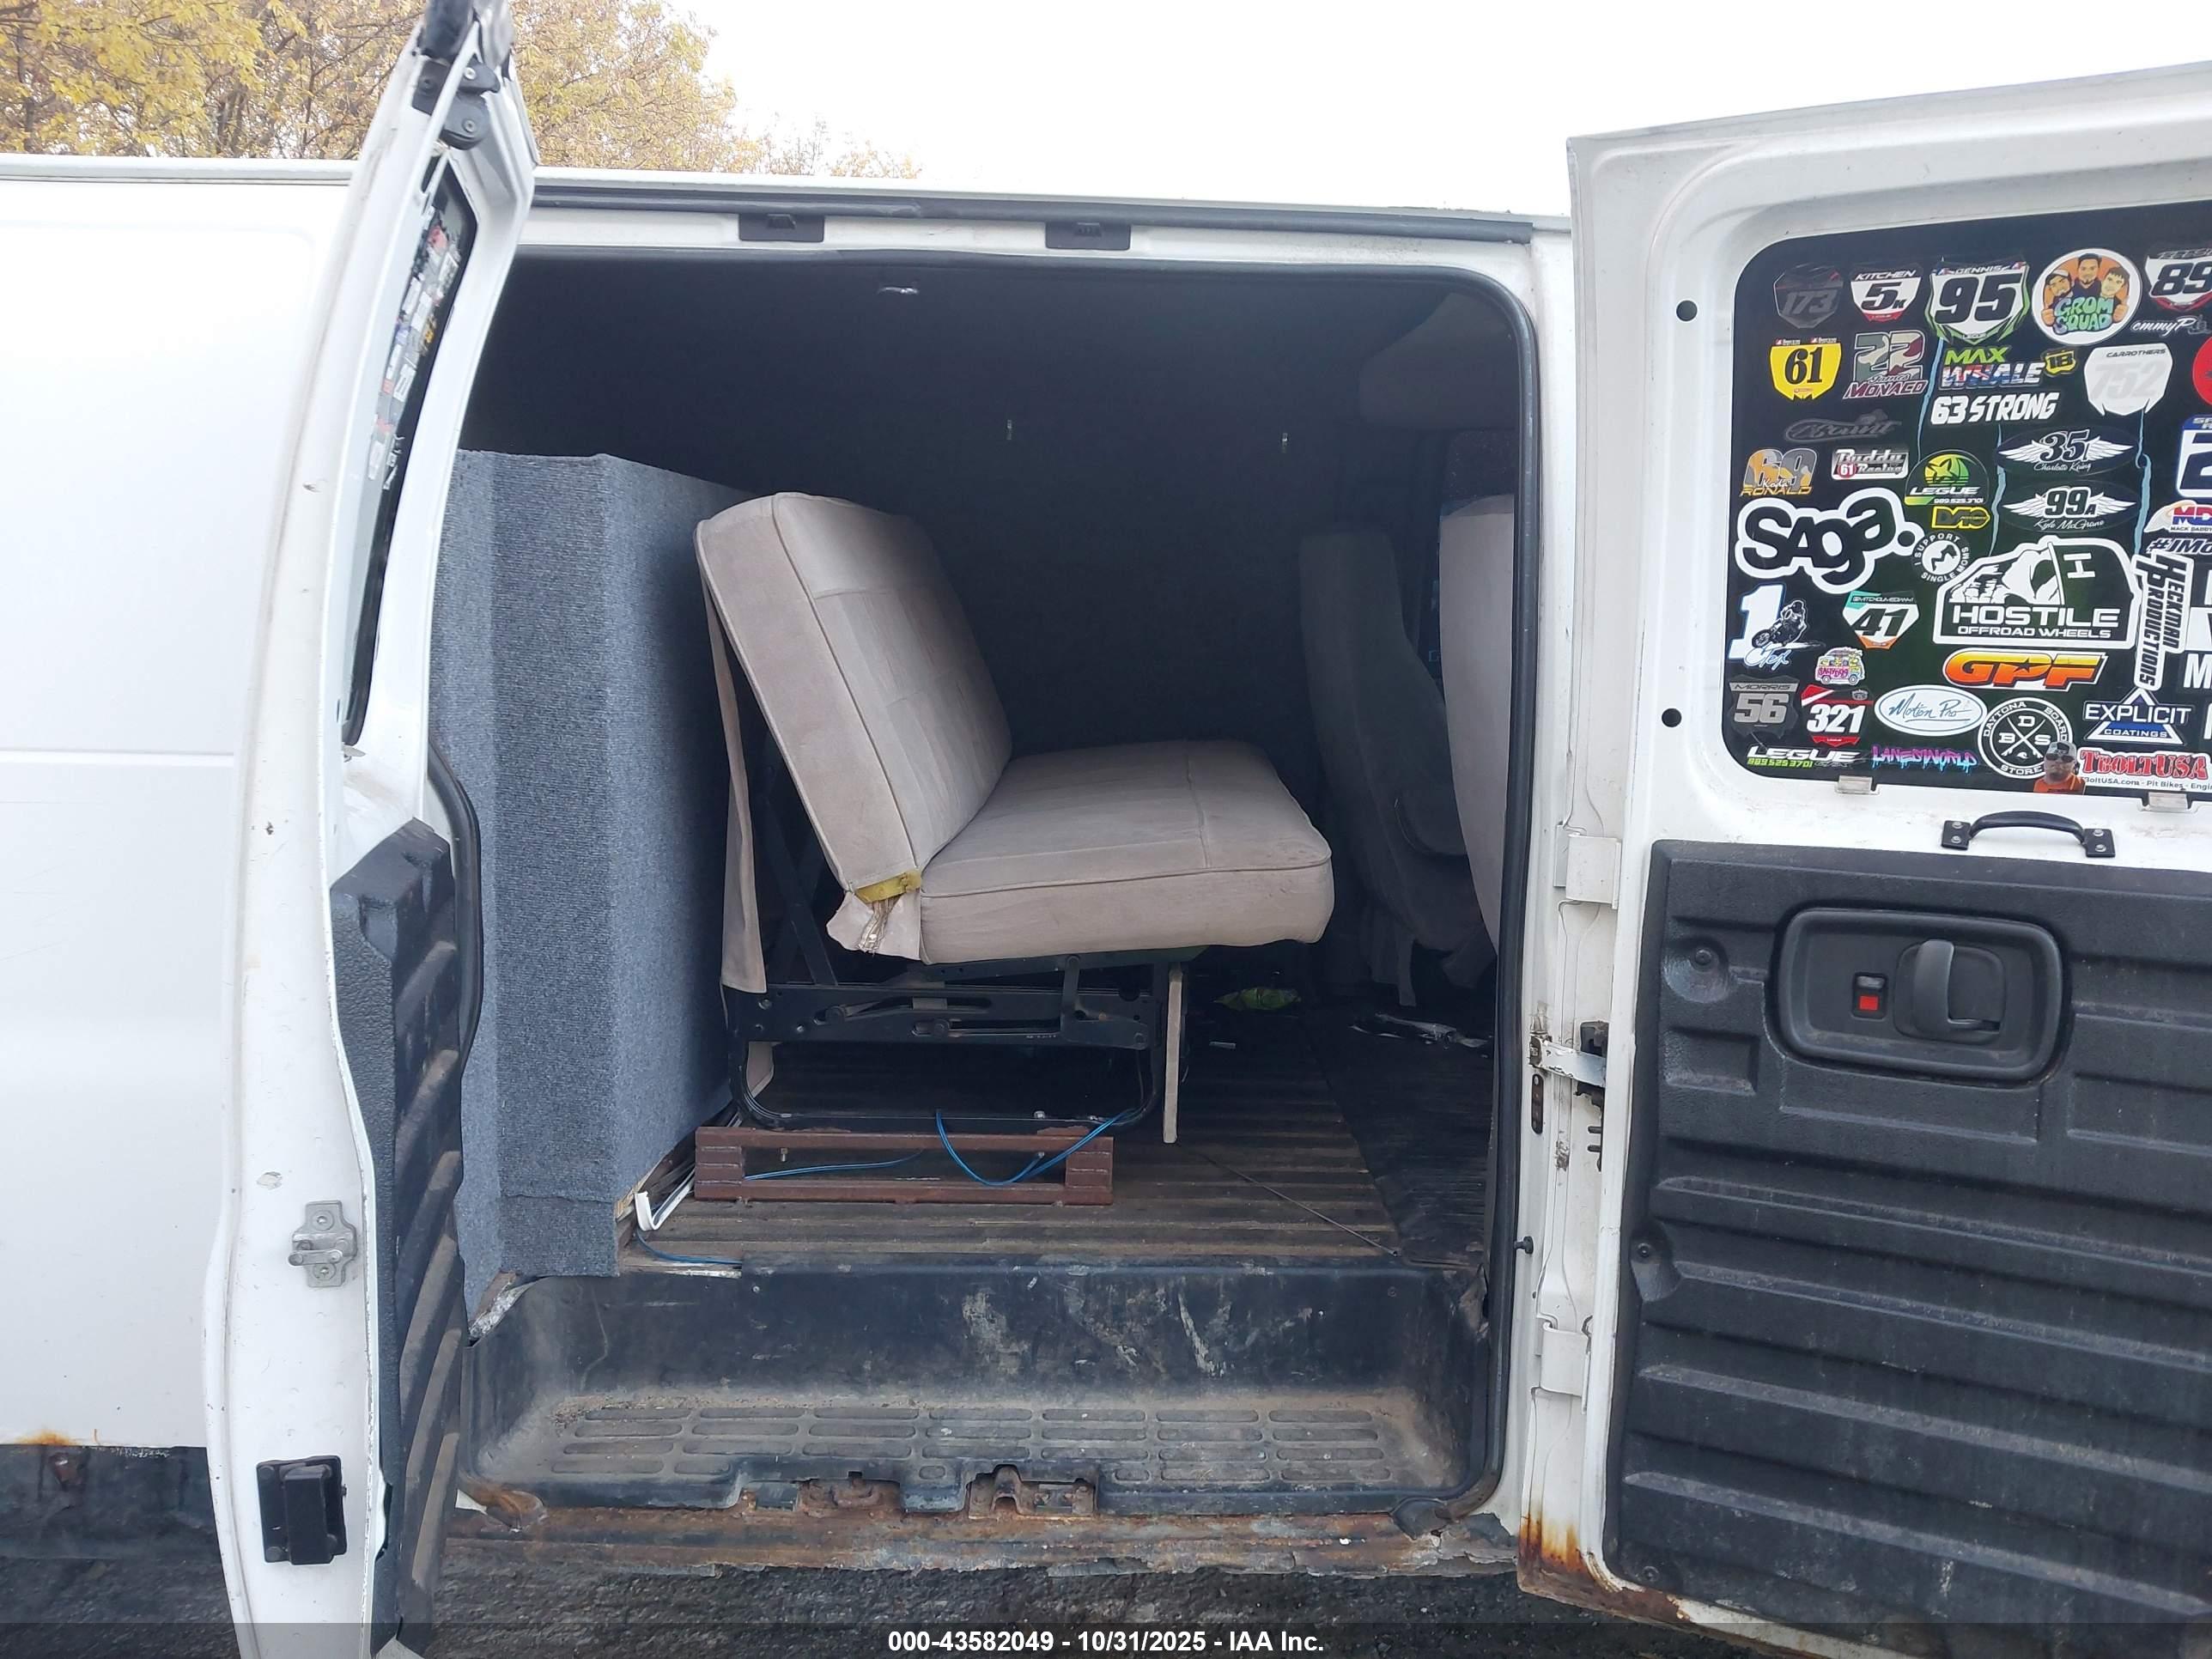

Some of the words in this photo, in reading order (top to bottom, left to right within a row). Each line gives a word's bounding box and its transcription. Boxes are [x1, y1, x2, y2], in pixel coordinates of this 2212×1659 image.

[1854, 270, 1917, 282] KITCHEN
[2151, 261, 2212, 296] 89
[1782, 290, 1837, 315] 173
[1935, 276, 2022, 325] 95
[2055, 296, 2114, 319] GROM
[2053, 314, 2112, 334] SQUAD
[1854, 330, 1925, 384] 22
[1944, 346, 2009, 365] MAX
[2106, 349, 2166, 357] CARROTHERS
[1785, 347, 1822, 385] 61
[1844, 380, 1929, 398] MONACO
[2090, 361, 2165, 398] 752
[1836, 449, 1904, 463] Buddy
[1745, 448, 1817, 489] 69
[1840, 465, 1854, 476] 61
[1857, 464, 1903, 475] Racing
[1740, 486, 1813, 496] RONALD
[2033, 519, 2057, 531] Kyle
[1914, 532, 1960, 558] SUPPORT
[1921, 572, 1956, 582] SINGLE
[1956, 546, 1970, 573] MOMS
[1855, 608, 1910, 637] 41
[1953, 605, 2120, 627] HOSTILE
[2136, 560, 2166, 687] PRODUCTIONS
[1958, 625, 2034, 636] OFFROAD
[2039, 628, 2111, 639] WHEELS
[1945, 650, 2101, 687] GPF
[1734, 693, 1789, 723] 56
[1889, 692, 1936, 719] Motion
[1939, 699, 1972, 718] Pro
[2085, 704, 2191, 724] EXPLICIT
[1807, 704, 1866, 733] 321
[1984, 702, 2027, 737] DAYTONA
[2044, 706, 2068, 742] BOARD
[2105, 728, 2168, 738] COATINGS
[1747, 745, 1861, 763] LEGUE
[2001, 764, 2042, 775] STORE
